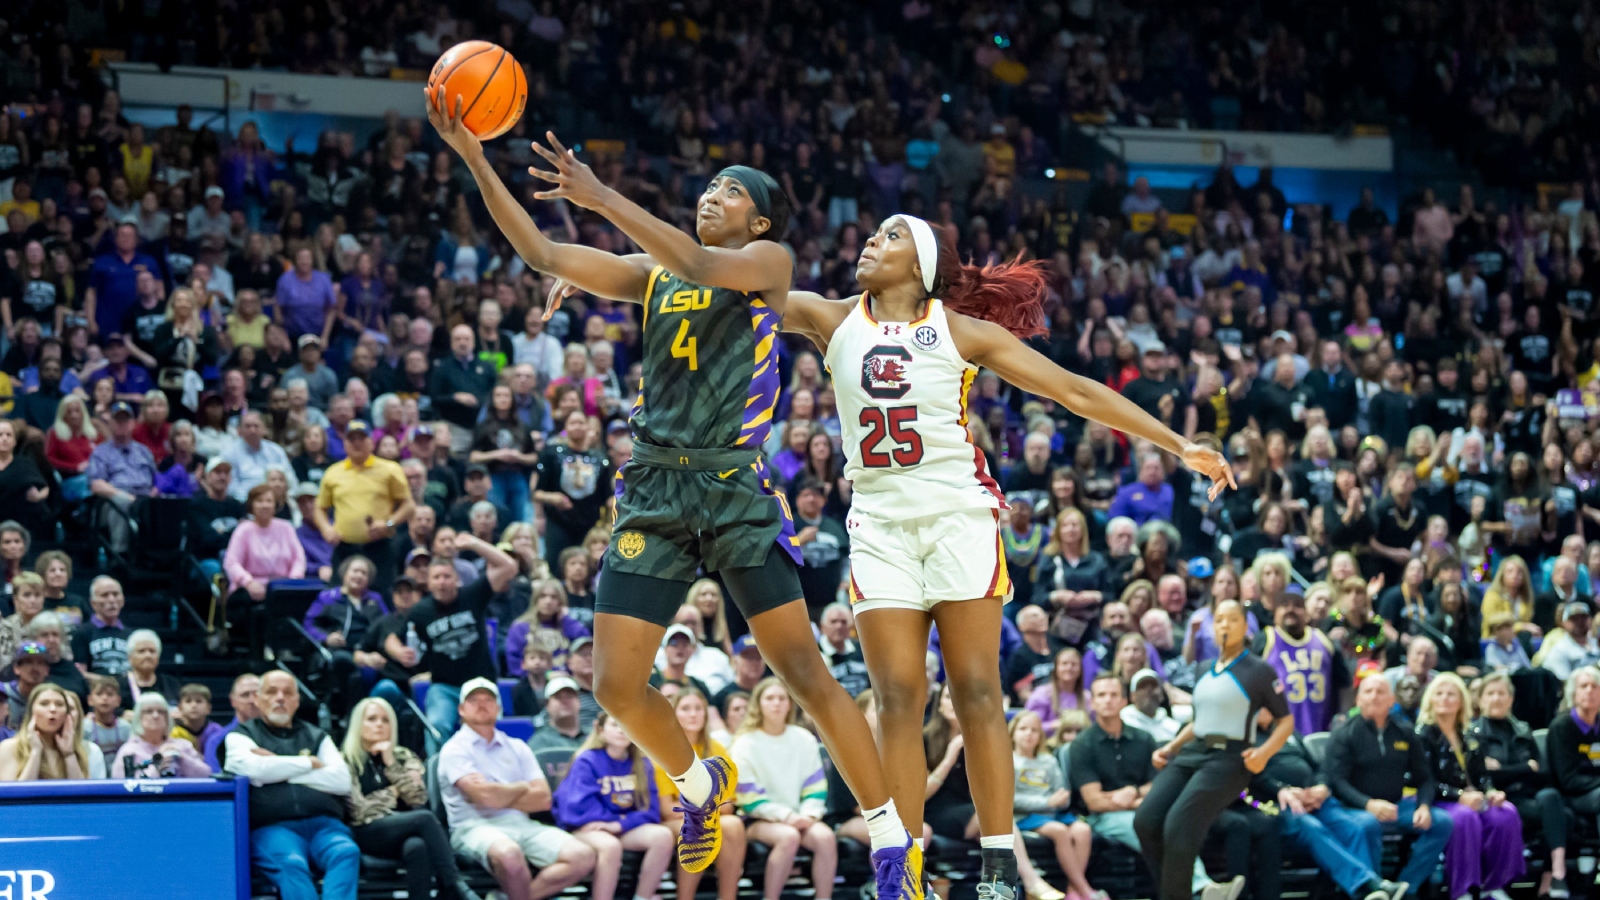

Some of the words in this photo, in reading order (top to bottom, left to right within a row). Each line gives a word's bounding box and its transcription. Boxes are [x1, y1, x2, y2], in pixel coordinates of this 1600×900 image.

[659, 289, 713, 314] LSU
[670, 318, 698, 371] 4
[916, 327, 937, 345] SEC
[859, 404, 924, 468] 25
[1279, 648, 1324, 673] LSU
[1285, 671, 1326, 703] 33
[0, 869, 56, 900] R
